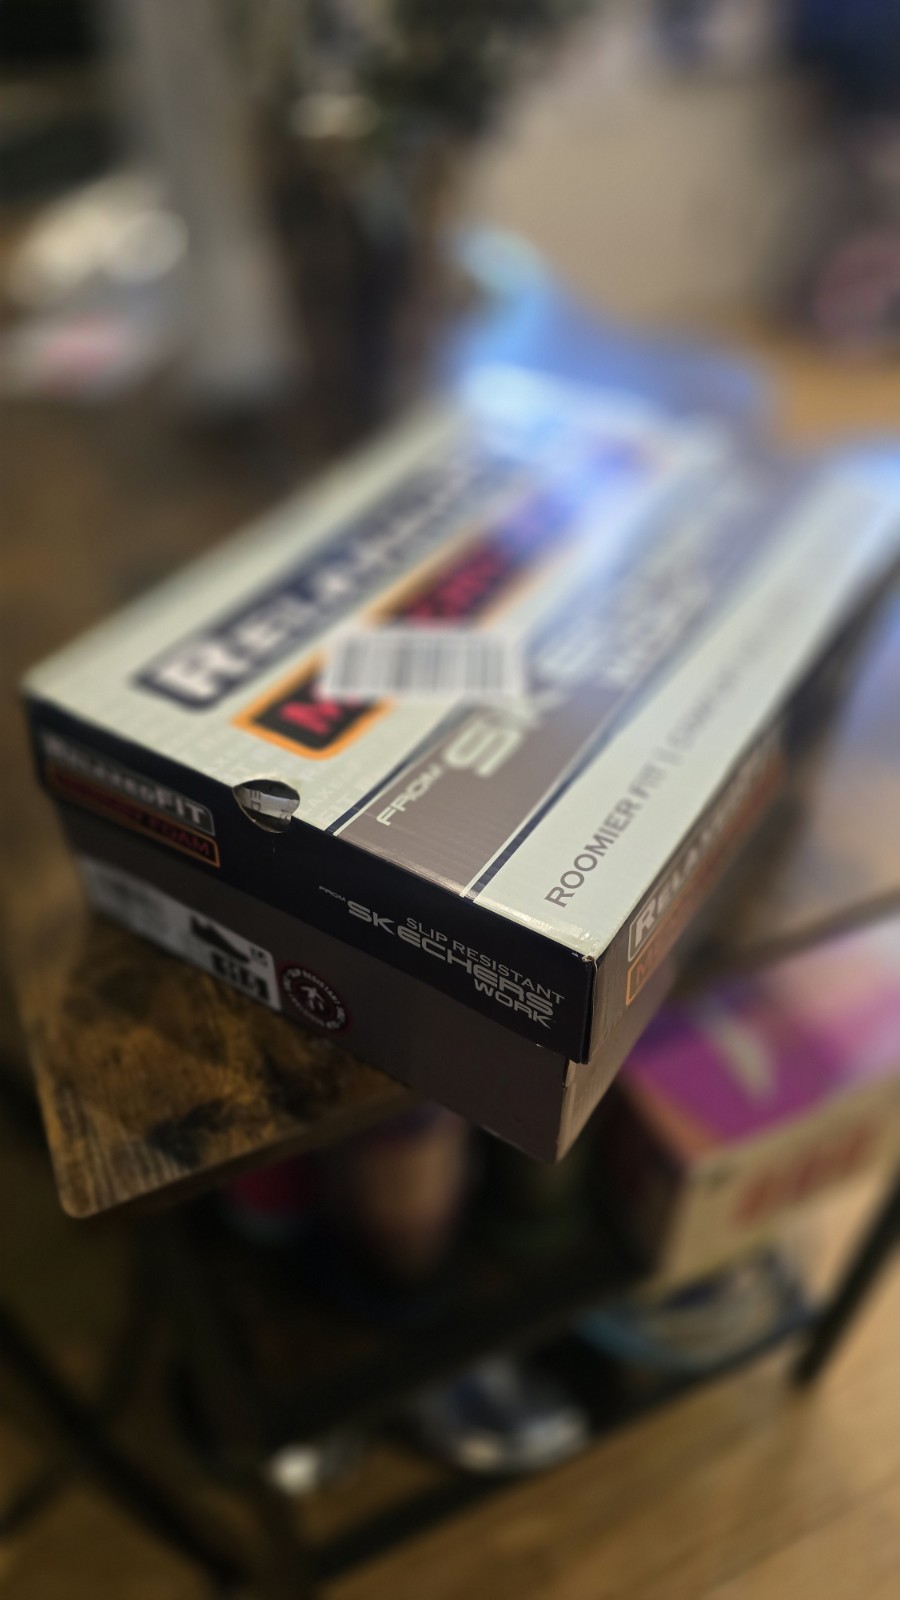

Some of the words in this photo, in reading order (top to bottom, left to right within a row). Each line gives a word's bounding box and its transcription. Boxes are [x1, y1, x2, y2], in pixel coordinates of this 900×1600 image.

[376, 764, 443, 827] FROM
[544, 793, 643, 908] ROOMIER
[318, 885, 346, 901] FROM
[347, 900, 554, 1017] SKECHERS
[406, 917, 448, 943] SLIP
[452, 939, 565, 1005] RESISTANT
[474, 978, 552, 1029] WORK
